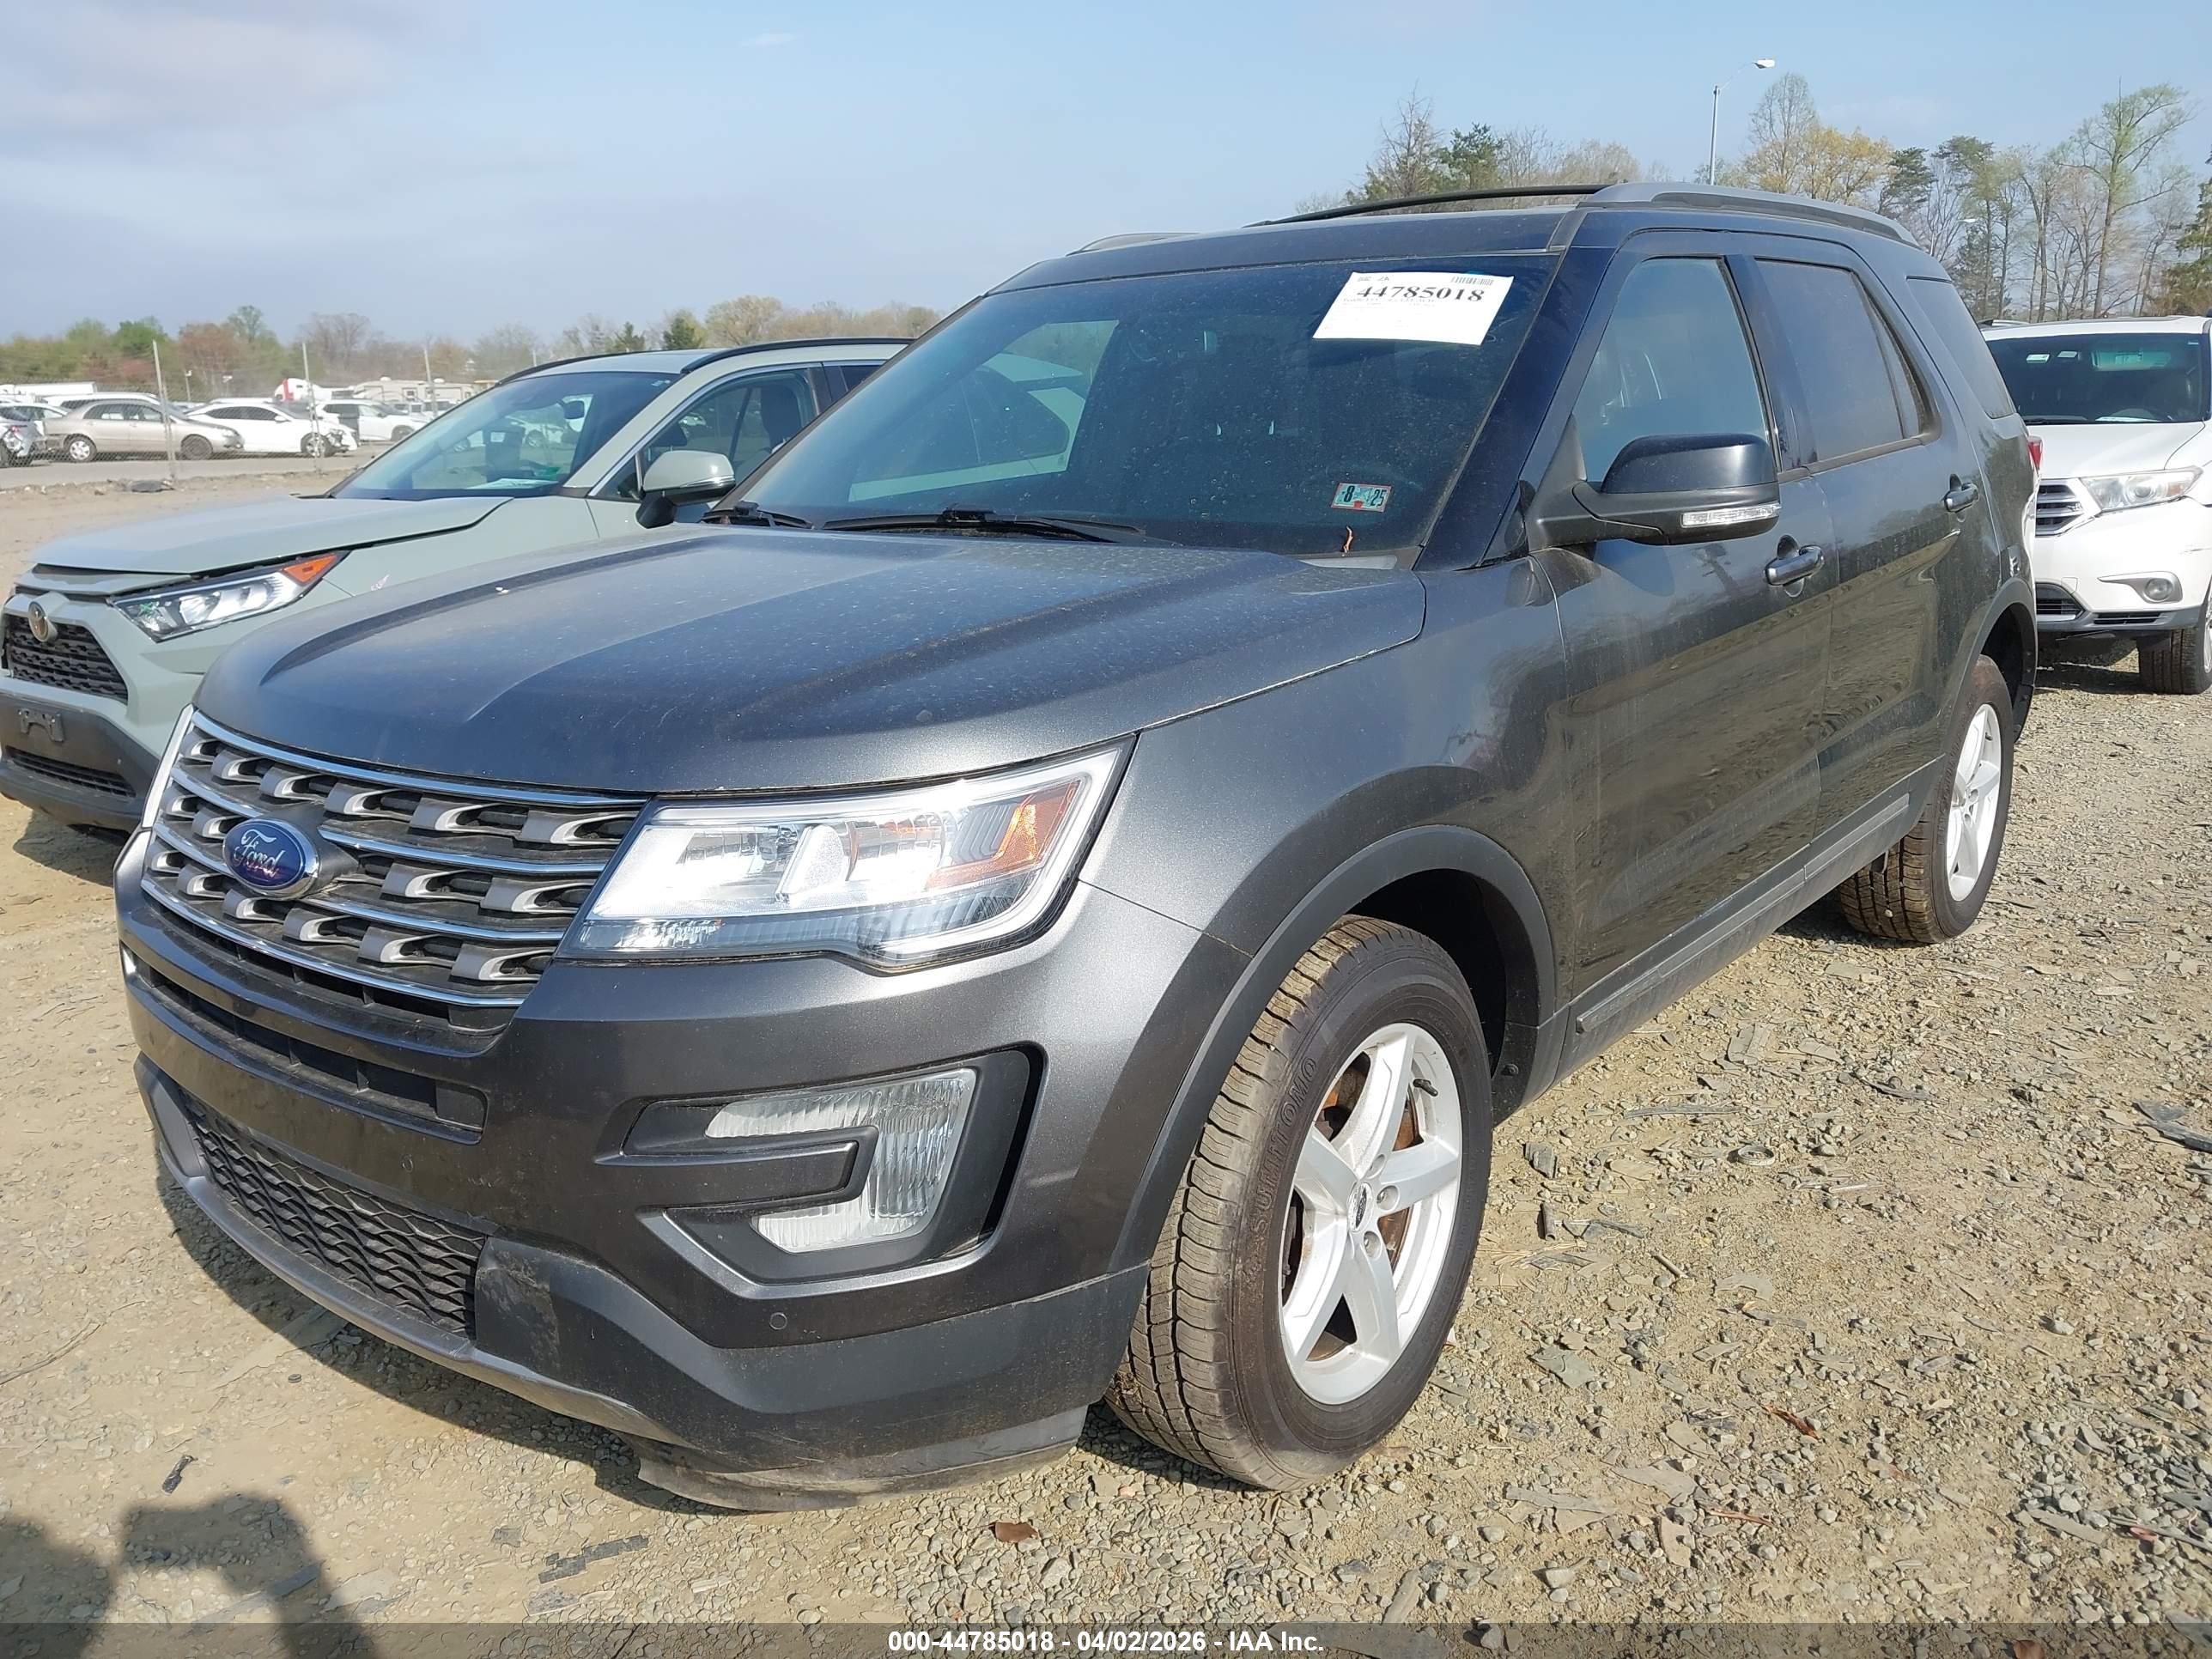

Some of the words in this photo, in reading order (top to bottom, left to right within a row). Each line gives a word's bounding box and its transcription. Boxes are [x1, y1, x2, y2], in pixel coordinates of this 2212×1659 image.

[1357, 286, 1485, 302] 44785018
[1343, 485, 1355, 502] 8
[1370, 489, 1387, 507] 25
[233, 829, 286, 872] Ford
[1250, 1057, 1316, 1234] SUMITOMO
